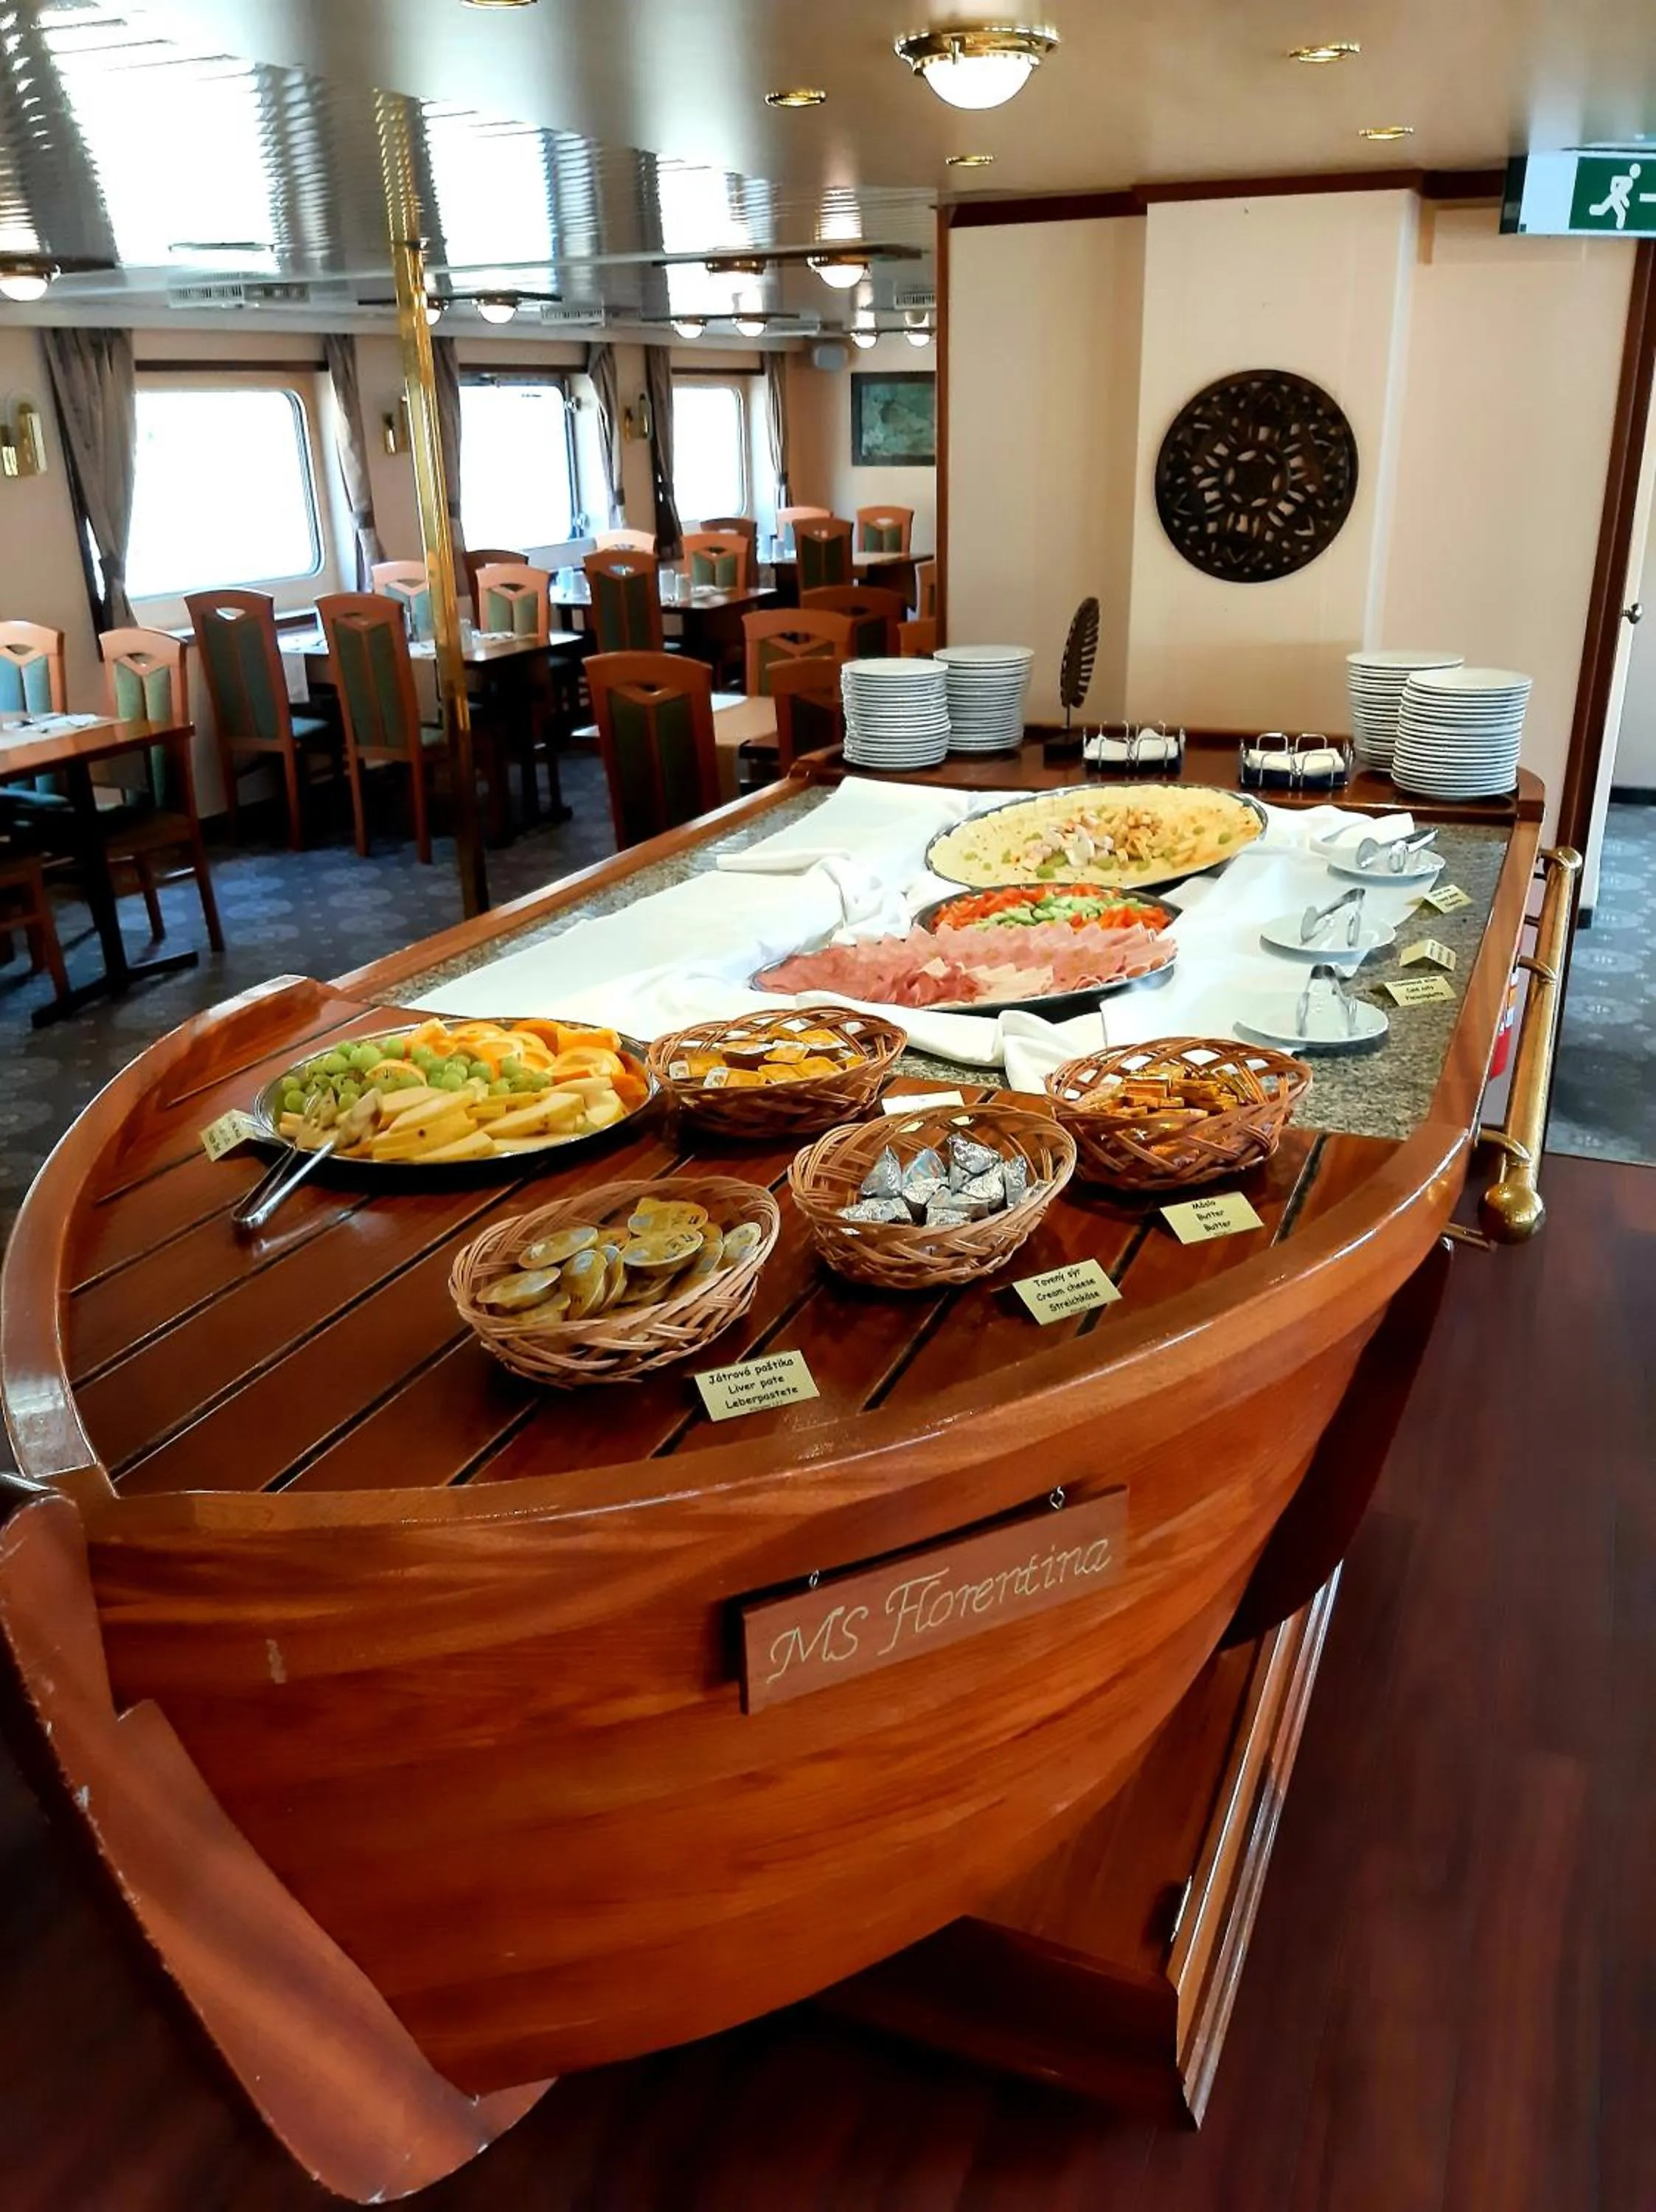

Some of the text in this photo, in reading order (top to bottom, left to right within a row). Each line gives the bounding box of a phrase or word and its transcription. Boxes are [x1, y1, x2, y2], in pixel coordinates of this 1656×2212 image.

[1196, 1210, 1224, 1221] Butter
[1203, 1220, 1231, 1231] Butter
[1036, 1278, 1096, 1301] Cream cheese
[709, 1358, 794, 1385] Játrová paštika
[728, 1376, 784, 1394] Liver pate
[725, 1387, 799, 1409] Leberpastete
[767, 1538, 1113, 1684] MS Florentina
